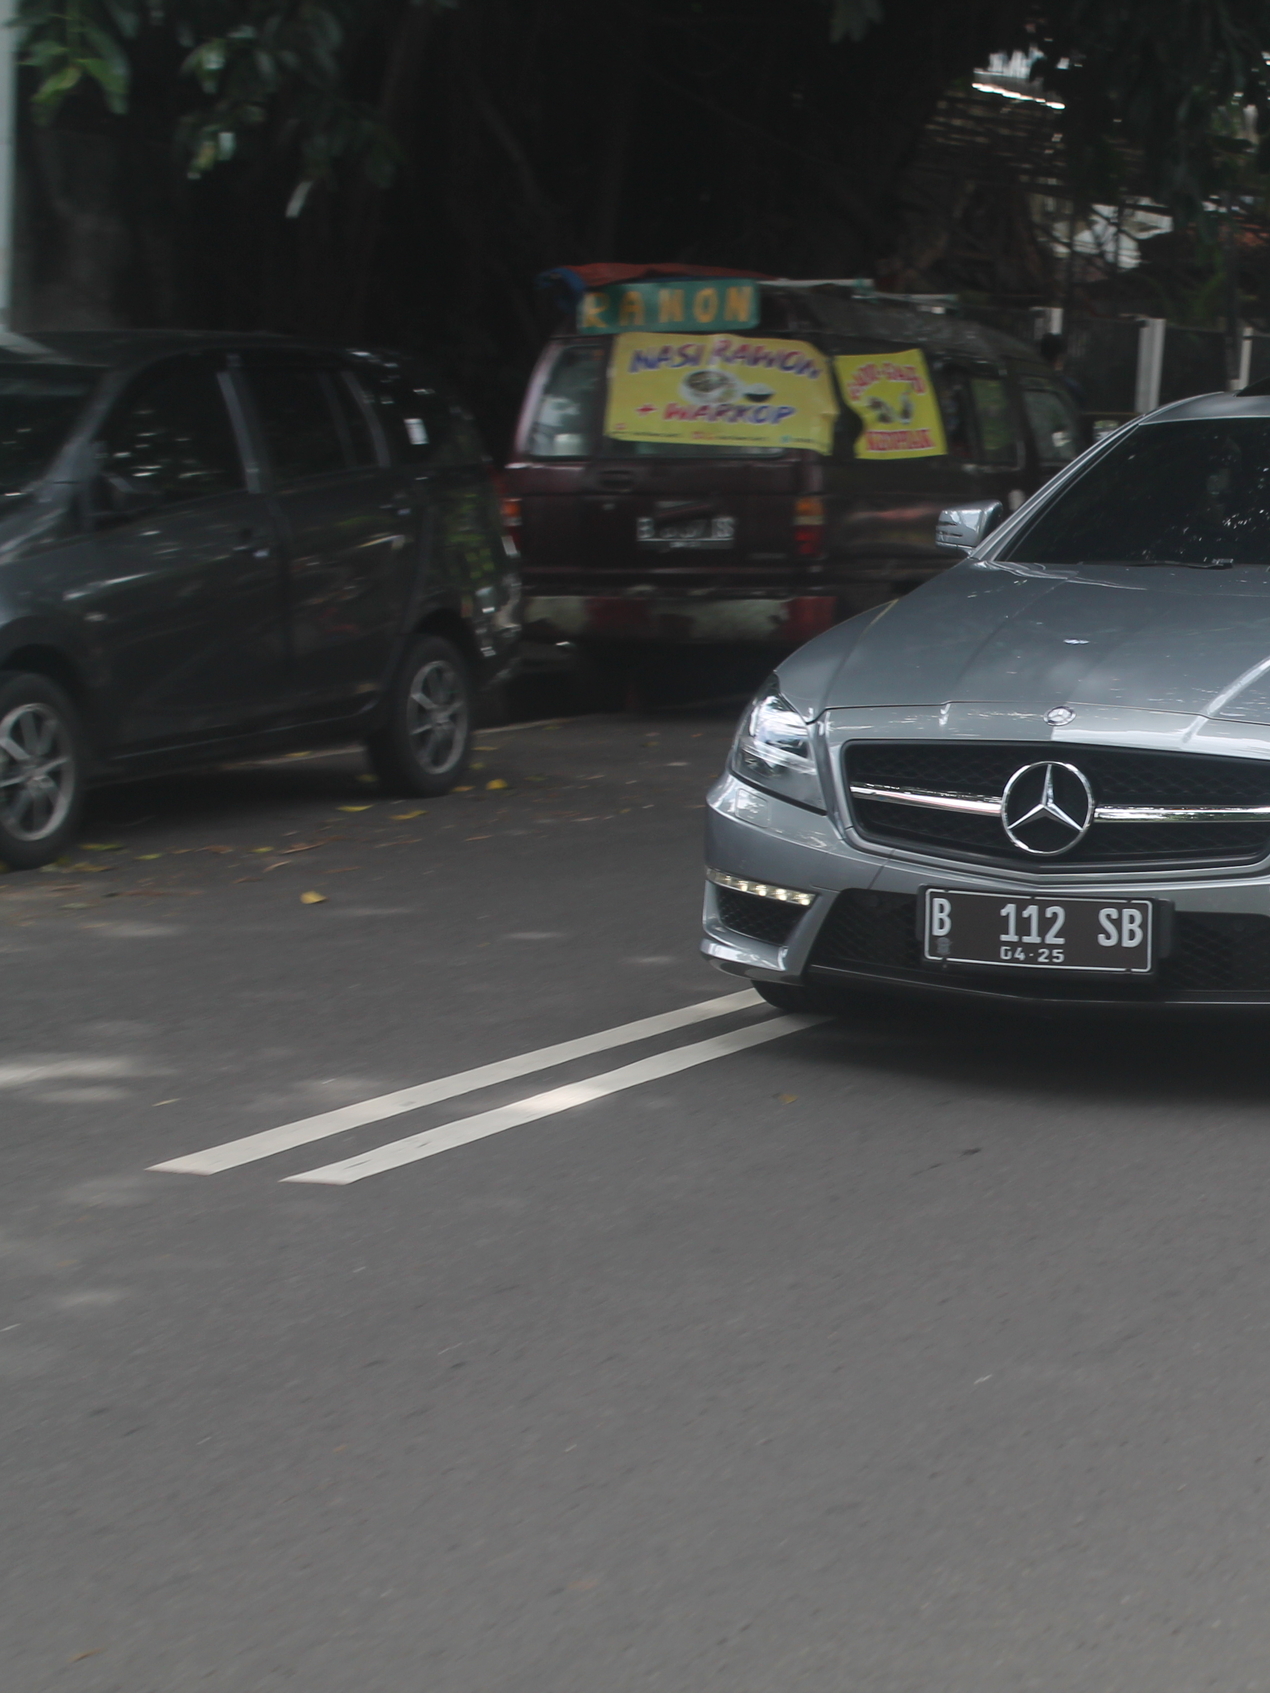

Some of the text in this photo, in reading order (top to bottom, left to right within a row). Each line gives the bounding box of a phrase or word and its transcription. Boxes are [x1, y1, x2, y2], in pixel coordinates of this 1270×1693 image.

[627, 343, 704, 374] NASI
[932, 898, 1143, 948] B 112 SB
